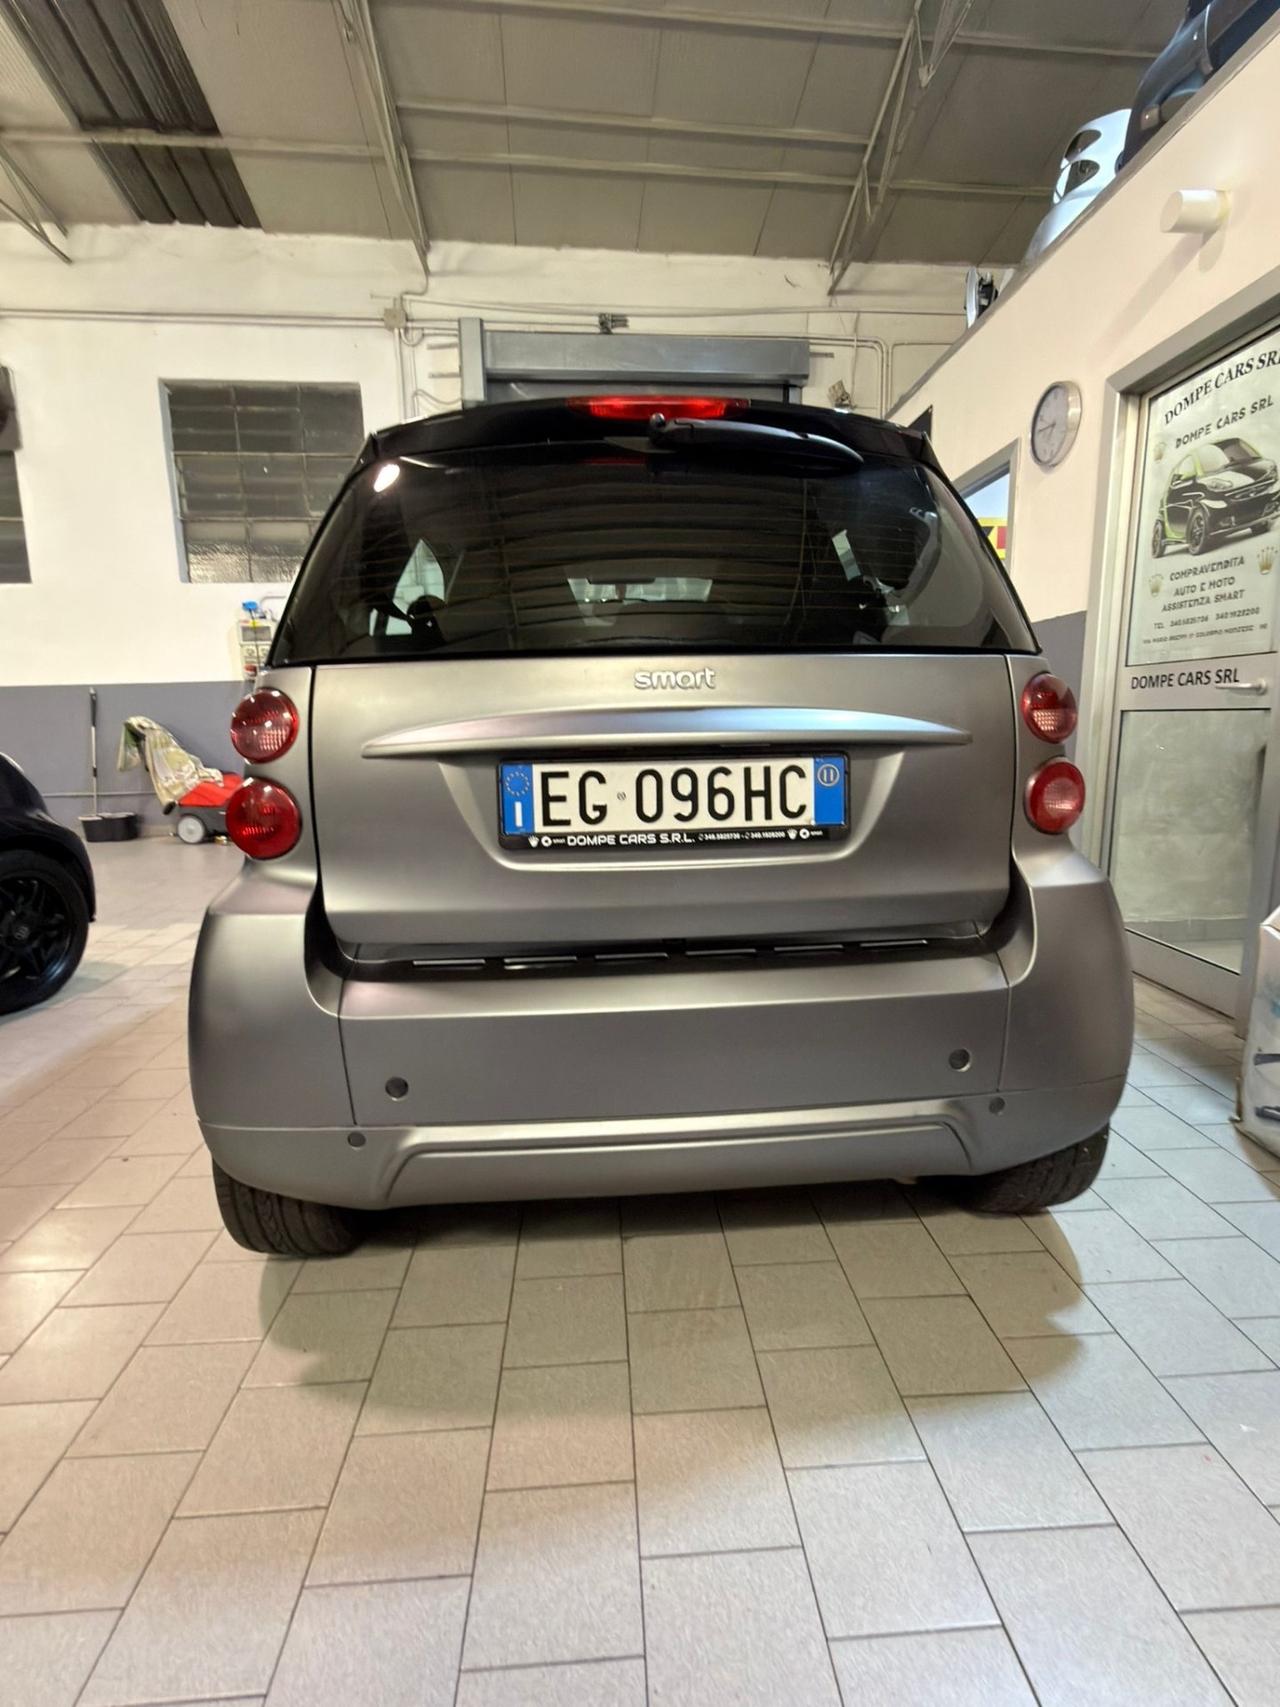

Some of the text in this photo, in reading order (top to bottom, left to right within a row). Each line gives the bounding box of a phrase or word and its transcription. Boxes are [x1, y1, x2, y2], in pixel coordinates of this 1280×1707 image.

[1164, 379, 1213, 425] DOMPE
[1214, 357, 1254, 389] CARS
[1175, 395, 1274, 449] DOMPE CARS SRL
[1174, 584, 1197, 597] AUTO
[1207, 576, 1236, 590] MOTO
[1161, 589, 1245, 613] ASSISTENZA SMART
[634, 667, 716, 690] smart
[1131, 667, 1240, 690] DOMPE CARS SRL
[541, 765, 808, 827] EG 096HC
[567, 834, 616, 847] DOMPE
[619, 833, 657, 846] CARS
[659, 832, 695, 845] S.R.L.
